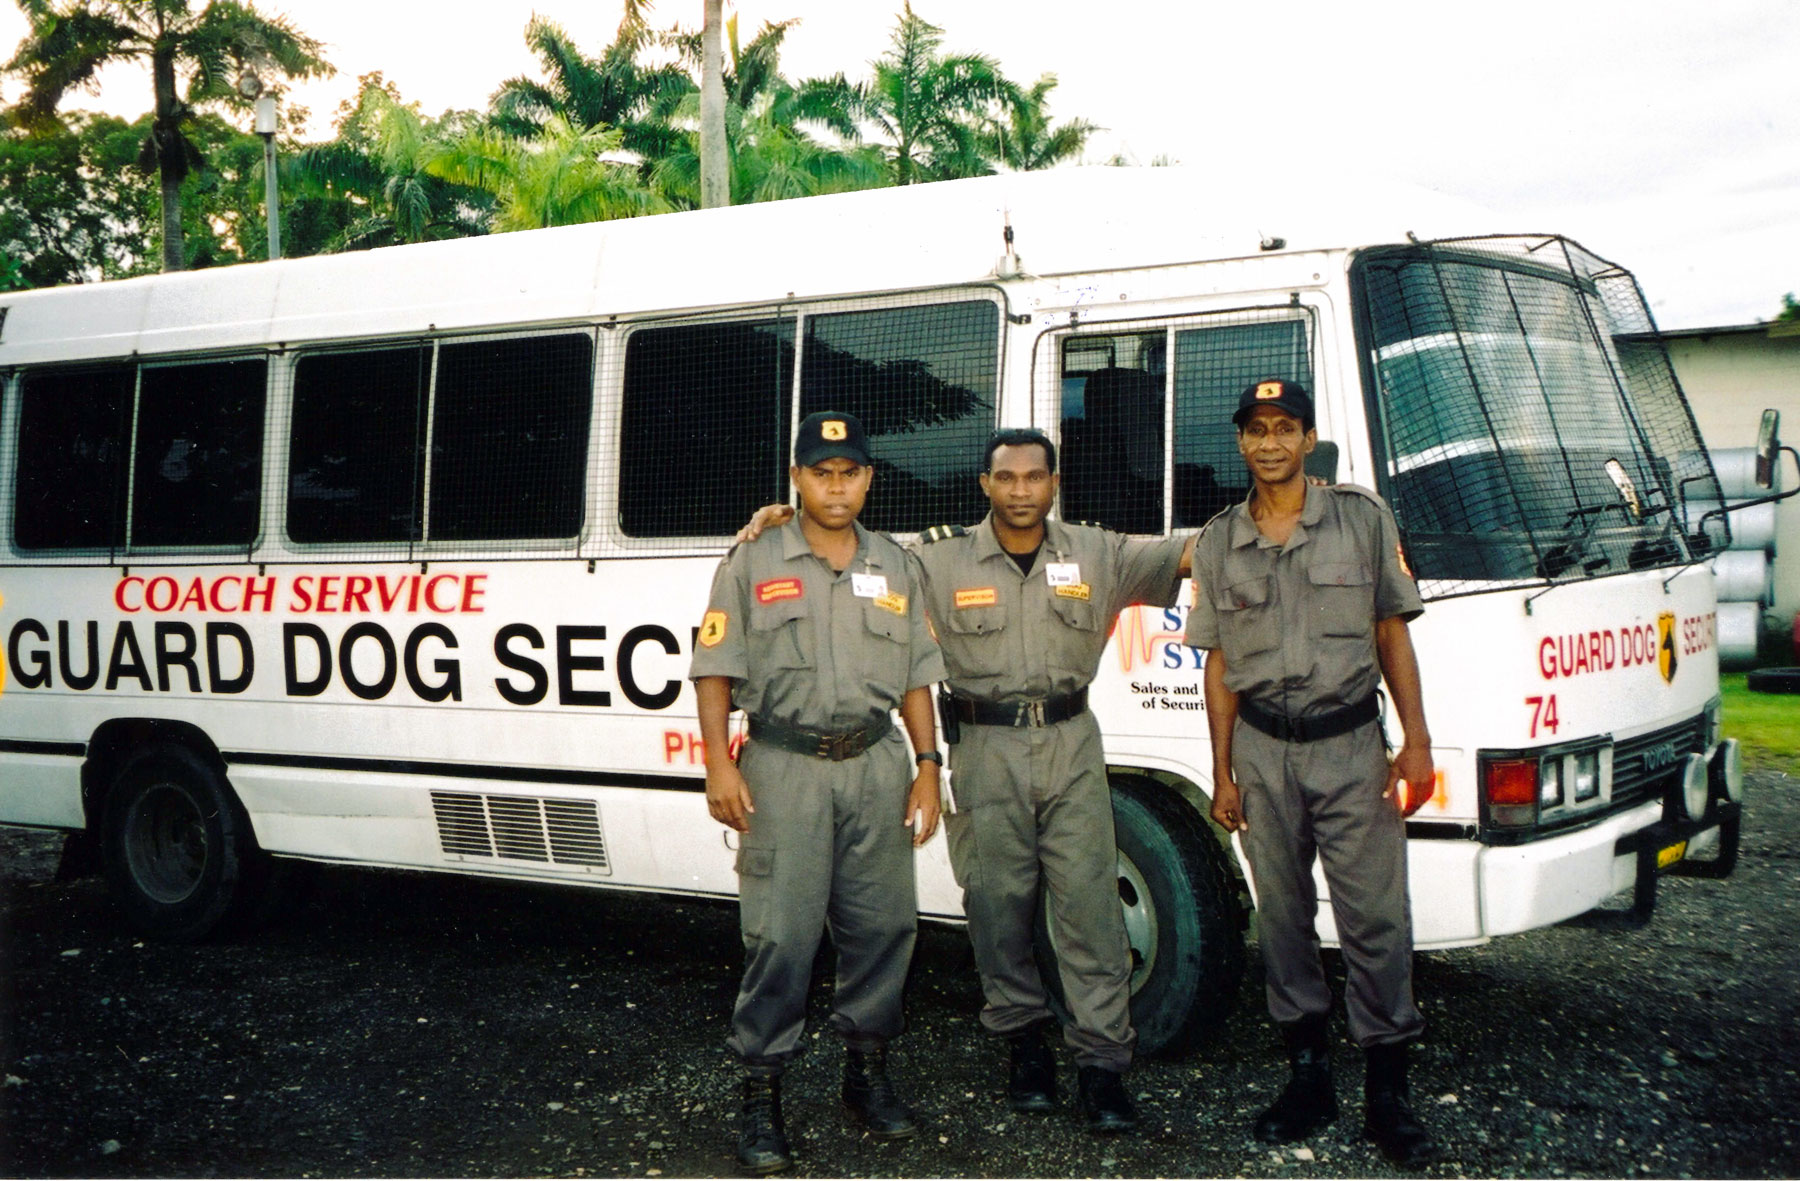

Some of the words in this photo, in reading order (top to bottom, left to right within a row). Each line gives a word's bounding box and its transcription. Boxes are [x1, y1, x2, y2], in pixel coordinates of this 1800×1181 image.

[115, 575, 274, 613] COACH
[290, 574, 488, 613] SERVICE
[8, 618, 255, 694] GUARD
[283, 622, 463, 703] DOG
[1539, 630, 1615, 680] GUARD
[1621, 624, 1656, 668] DOG
[1130, 681, 1168, 695] Sales
[1173, 683, 1199, 695] and
[1142, 697, 1156, 709] of
[1161, 698, 1205, 711] Securi
[1525, 694, 1559, 738] 74
